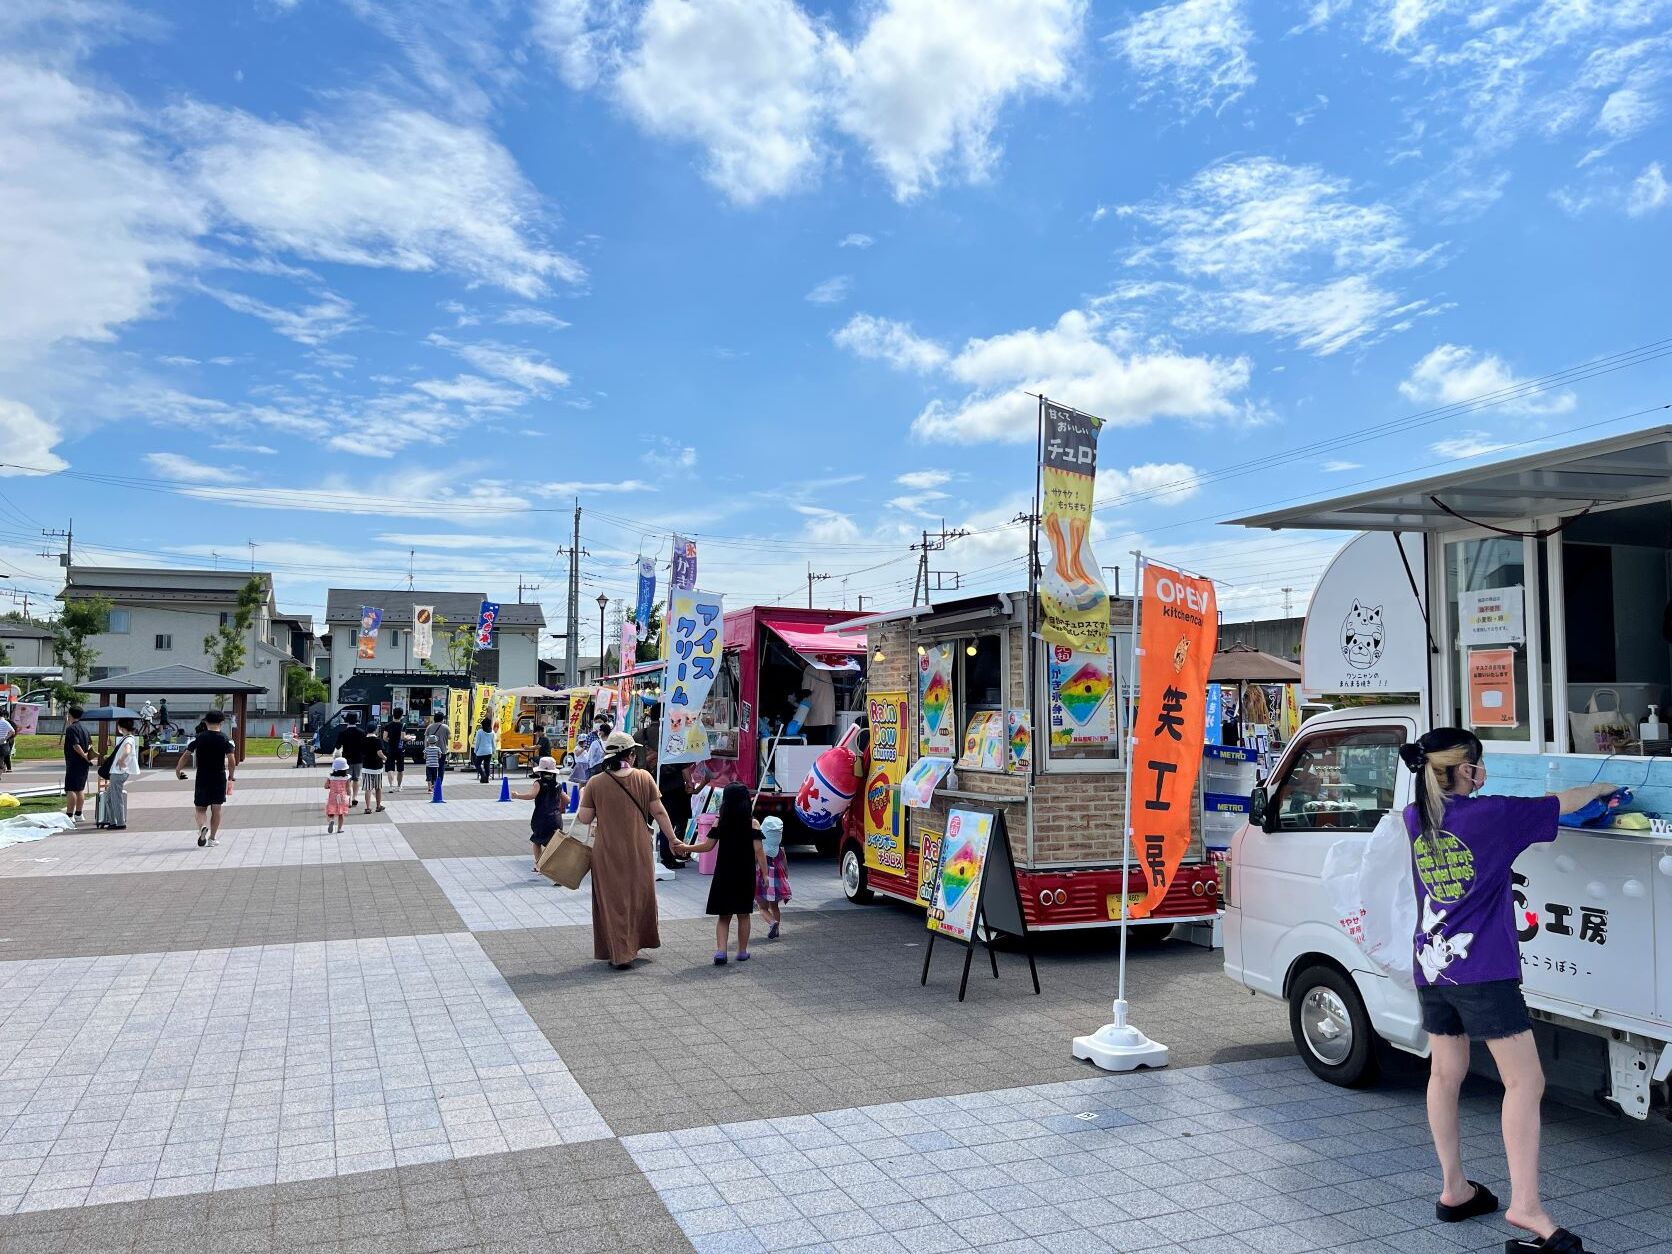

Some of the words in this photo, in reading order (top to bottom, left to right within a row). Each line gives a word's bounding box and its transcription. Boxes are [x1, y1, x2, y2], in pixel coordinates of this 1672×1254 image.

[1049, 409, 1070, 421] 甘くて
[1058, 422, 1089, 435] おいしい
[1157, 578, 1208, 614] OPEN
[693, 604, 719, 679] アイス
[672, 617, 696, 705] クリーム
[1052, 669, 1063, 726] かき氷弁当
[569, 699, 585, 738] お弁当
[870, 699, 896, 723] Rain
[873, 723, 896, 745] Bow
[873, 747, 896, 762] churros
[1220, 751, 1246, 759] METRO
[1145, 685, 1187, 888] 笑工房
[1217, 803, 1243, 811] METRO
[879, 850, 903, 870] チュロス
